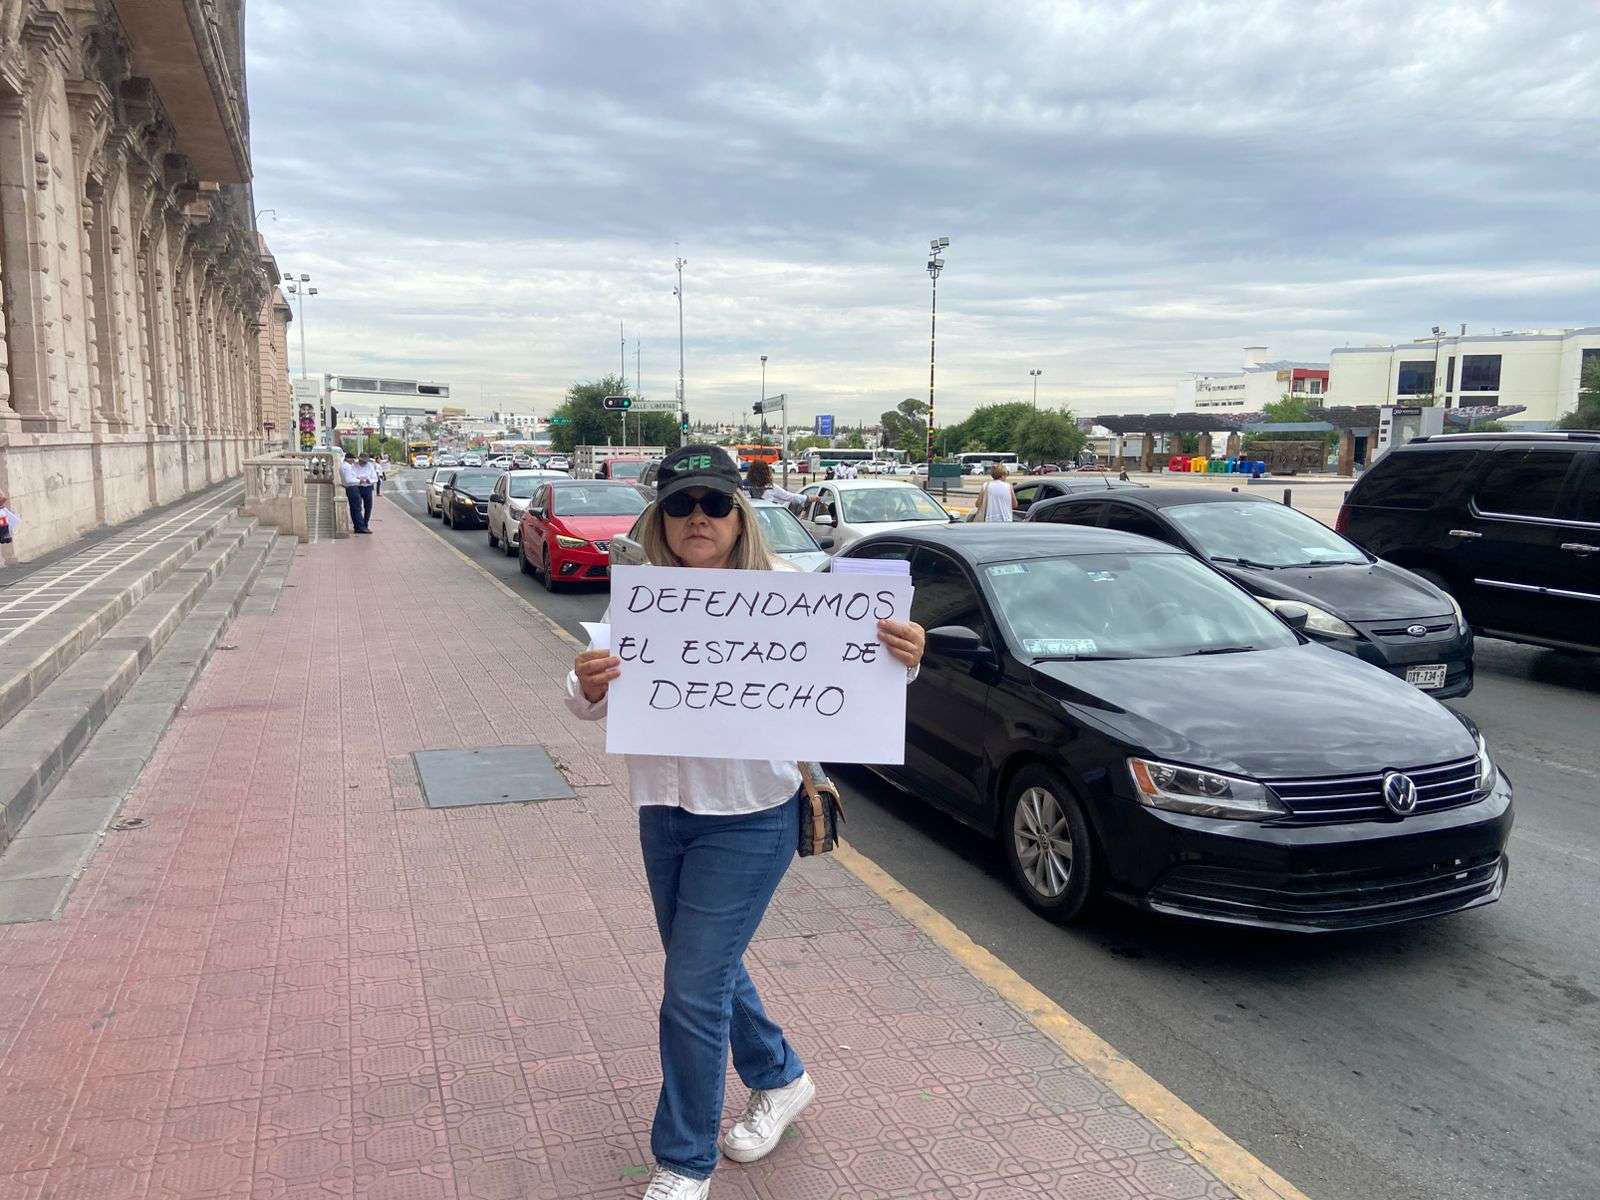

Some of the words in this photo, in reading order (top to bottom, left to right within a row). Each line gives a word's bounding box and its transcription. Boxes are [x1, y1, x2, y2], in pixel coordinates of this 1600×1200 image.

[673, 455, 712, 471] CFE
[627, 585, 895, 621] DEFENDAMOS
[618, 636, 655, 664] EL
[681, 640, 808, 665] ESTADO
[841, 642, 880, 663] DE
[649, 680, 845, 716] DERECHO
